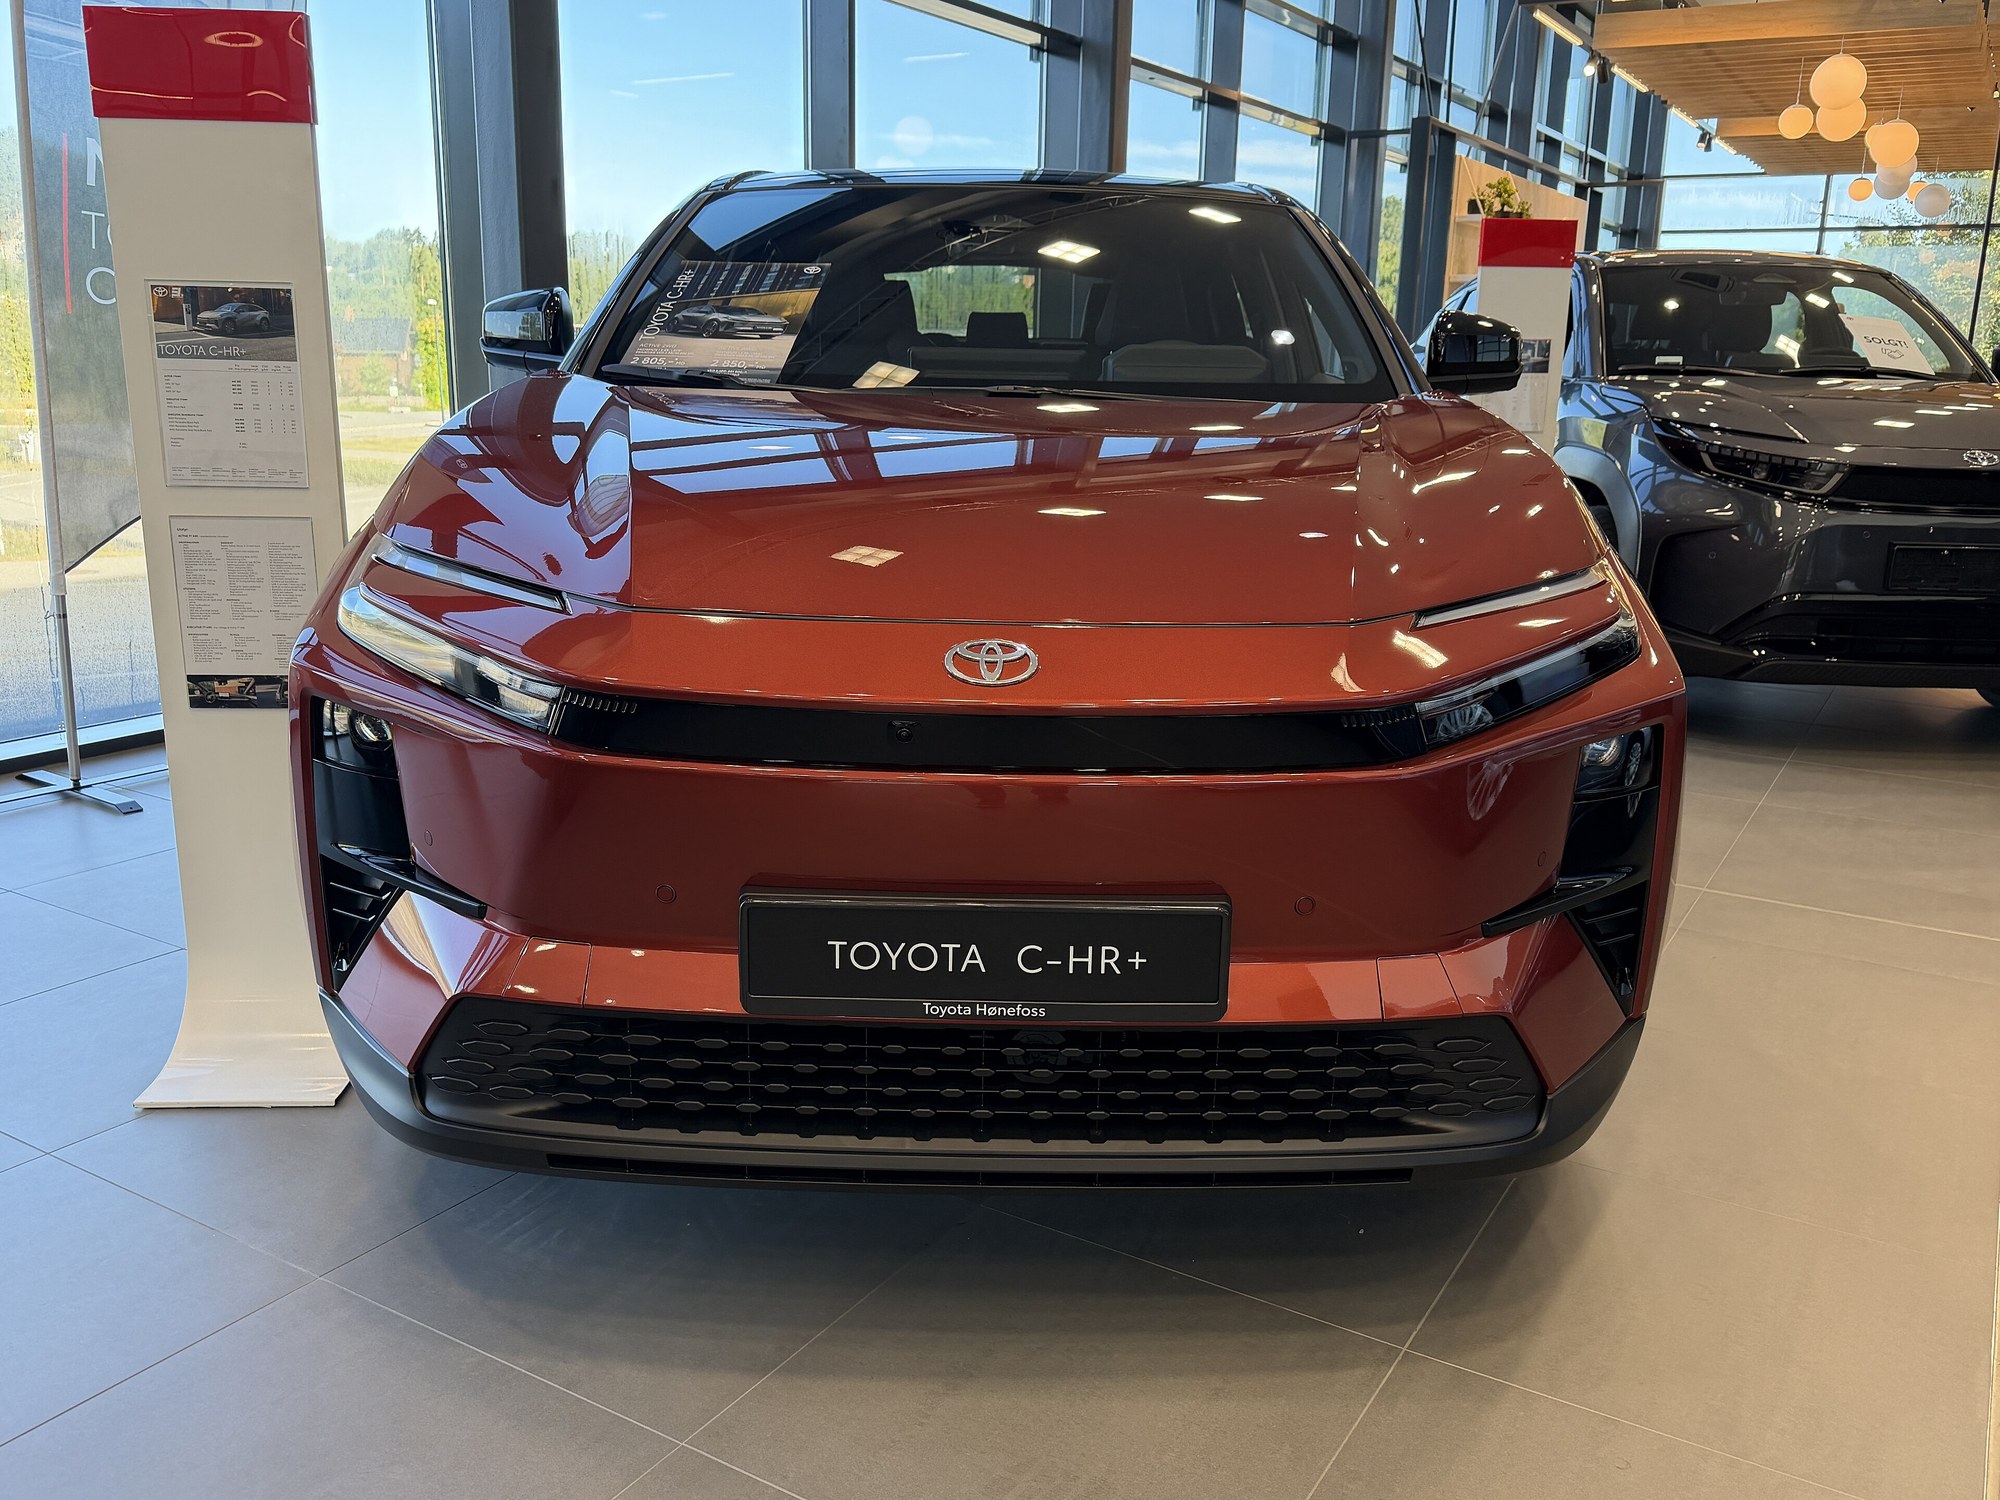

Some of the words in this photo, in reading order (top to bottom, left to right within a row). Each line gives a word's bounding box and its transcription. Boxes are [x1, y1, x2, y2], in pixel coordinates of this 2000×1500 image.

[639, 301, 677, 341] TOYOTA
[666, 269, 695, 299] C-HR+
[1863, 335, 1909, 349] SOLGT!
[158, 344, 206, 356] TOYOTA
[208, 345, 247, 357] C-HR+
[630, 356, 640, 364] 2
[710, 359, 720, 367] 2
[827, 940, 986, 973] TOYOTA
[1016, 944, 1147, 975] C-HR+
[922, 1002, 972, 1018] Toyota
[976, 1003, 1046, 1018] Hønefoss
